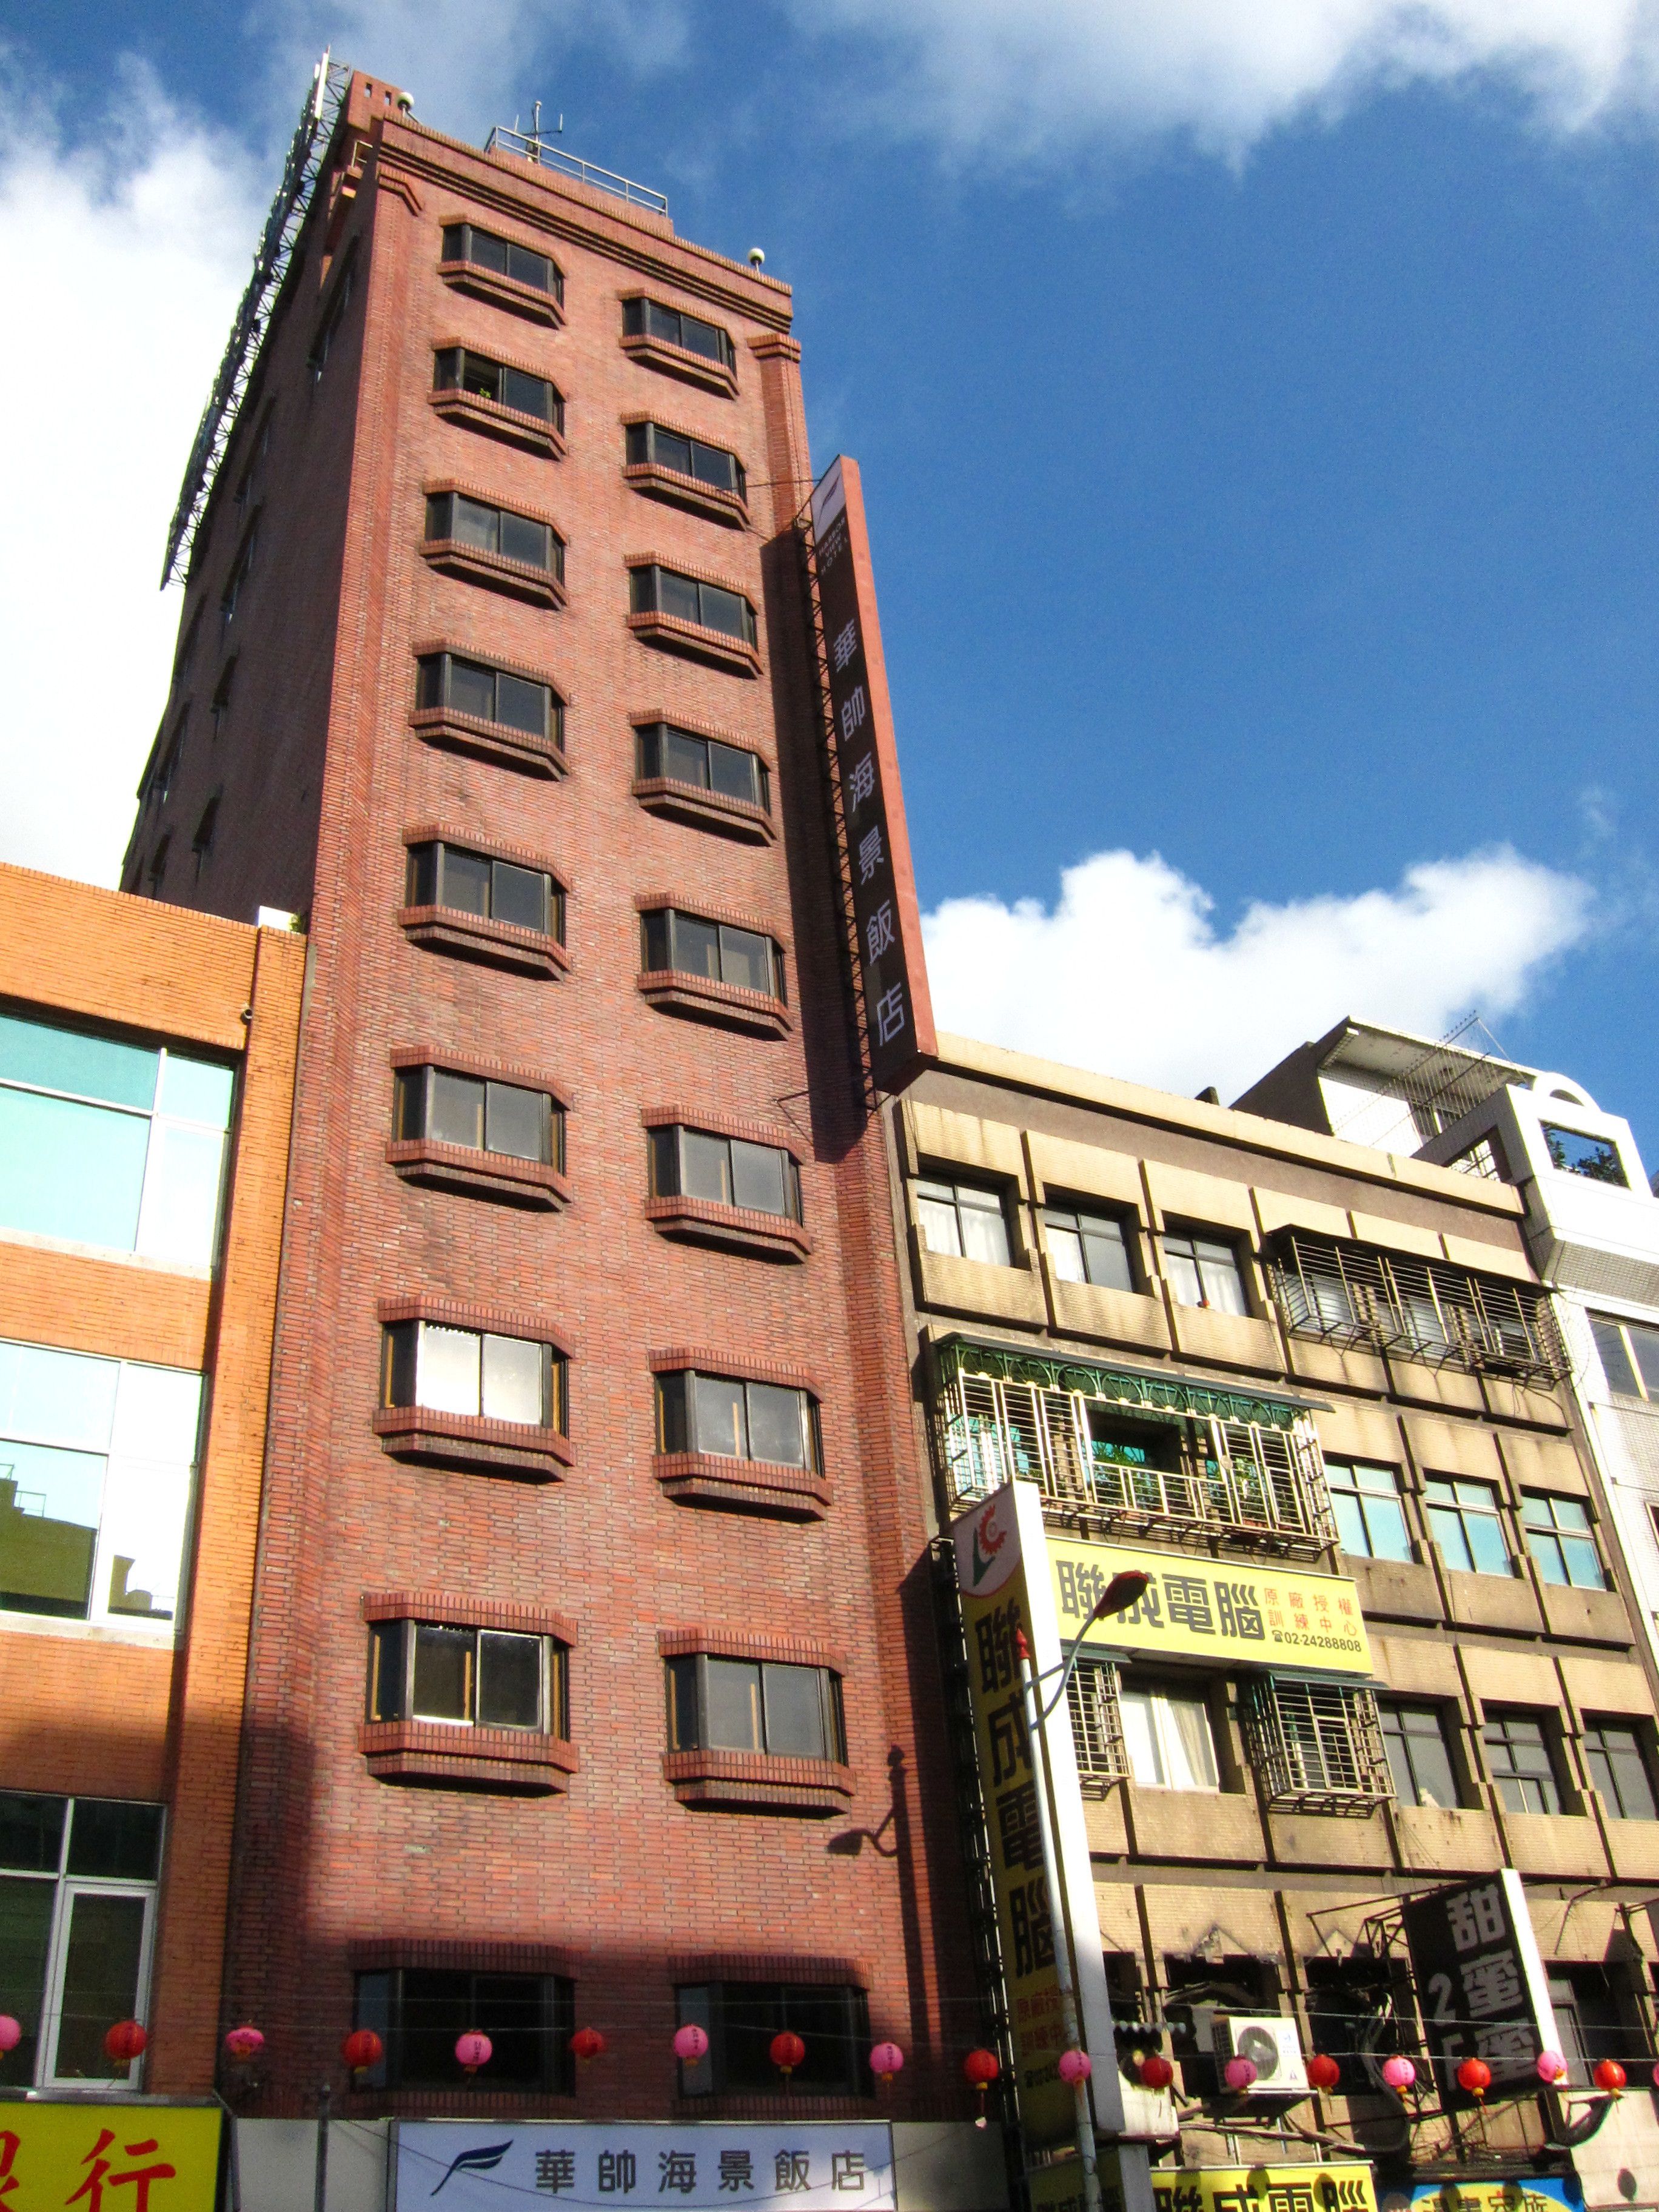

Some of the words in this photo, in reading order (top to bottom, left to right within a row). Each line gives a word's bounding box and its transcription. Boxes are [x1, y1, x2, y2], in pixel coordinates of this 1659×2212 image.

[834, 618, 905, 1047] 華帥海景飯店
[1264, 1587, 1353, 1615] 原廠授權
[1268, 1609, 1357, 1637] 訓練中心
[535, 2149, 865, 2194] 華帥海景飯店
